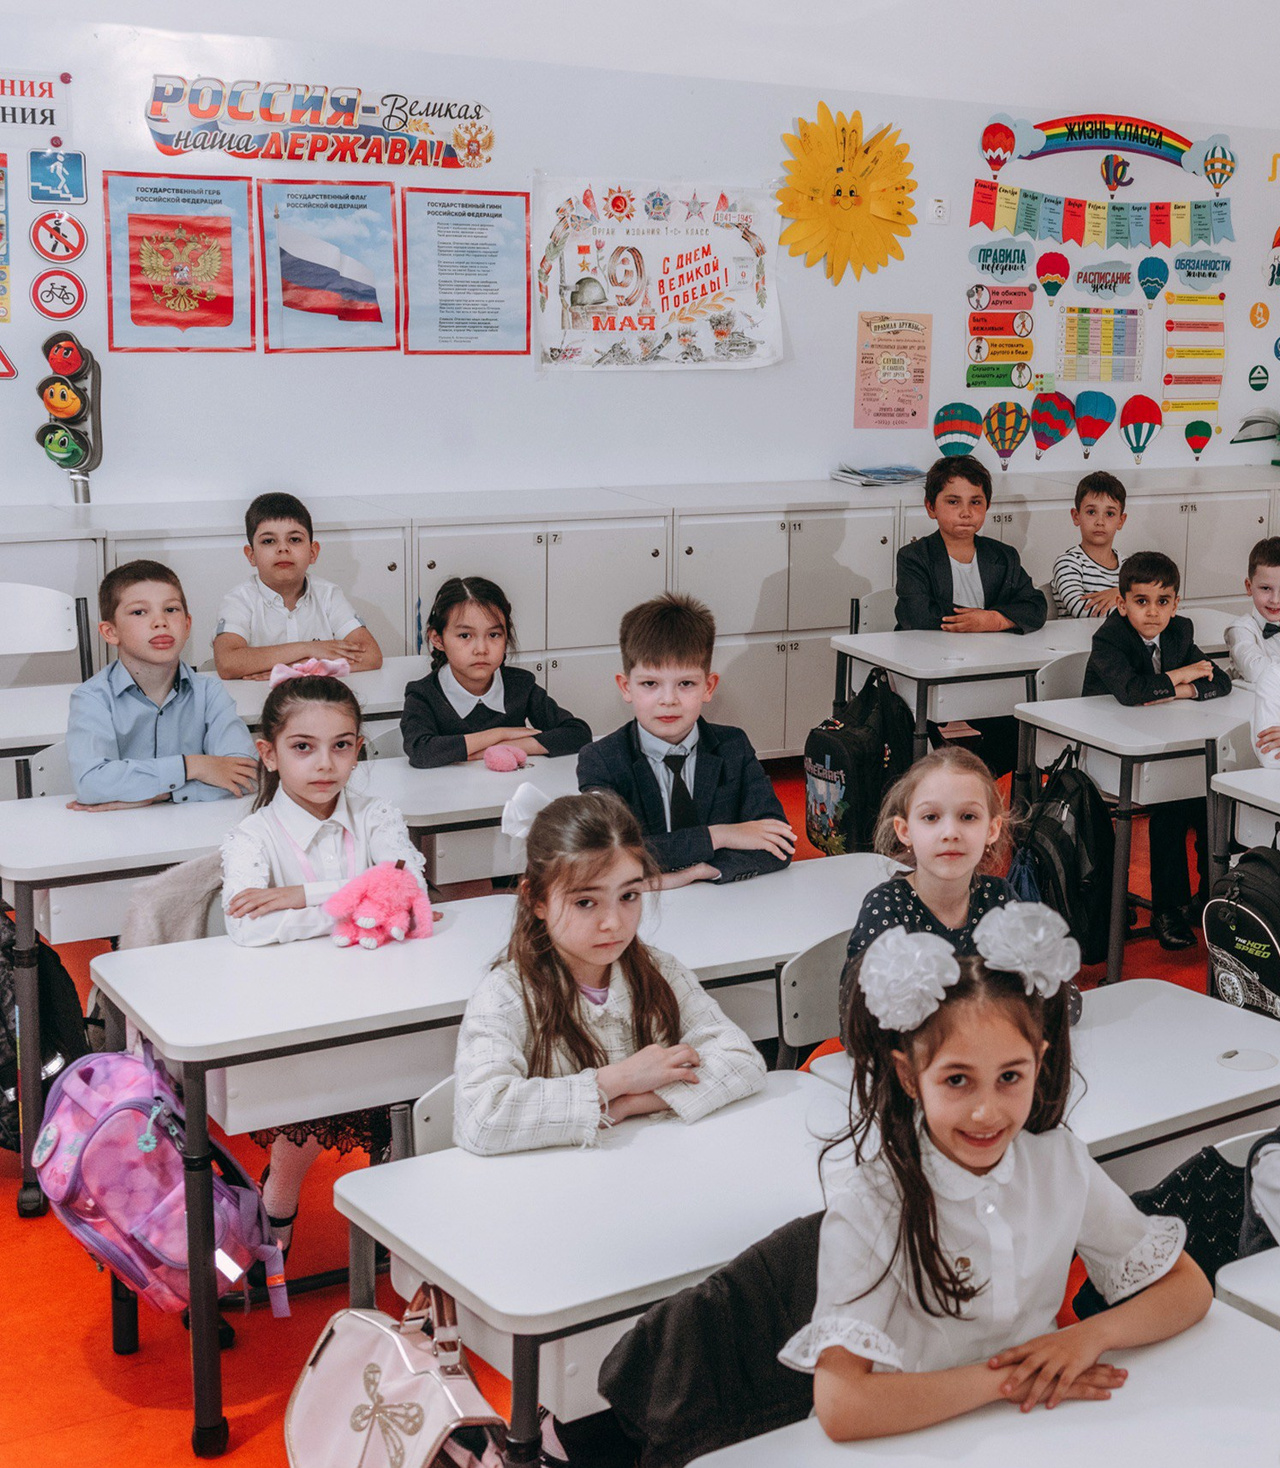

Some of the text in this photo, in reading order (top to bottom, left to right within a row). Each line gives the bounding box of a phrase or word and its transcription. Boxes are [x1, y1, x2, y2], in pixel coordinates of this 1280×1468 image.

[0, 106, 56, 125] НИЯ
[381, 93, 484, 131] Великая
[1065, 120, 1164, 149] ЖИЗНЬ КЛАССА
[173, 129, 444, 167] наша ДЕРЖАВА!
[136, 187, 203, 196] ГОСУДАРСТВЕННЫЙ
[135, 196, 222, 206] РОССИЙСКОЙ ФЕДЕРАЦИИ
[286, 193, 349, 201] ГОСУДАРСТВЕННЫЙ
[286, 202, 328, 210] РОССИЙСКОЙ
[427, 201, 485, 209] ГОСУДАРСТВЕННЫЙ
[427, 210, 466, 218] РОССИЙСКОЙ
[662, 244, 712, 275] С ДНЕМ
[978, 249, 1026, 264] ПРАВИЛА
[981, 262, 1026, 275] поведения
[1175, 259, 1231, 271] ОБЯЗАННОСТИ
[657, 256, 720, 296] ВЕЛИКОЙ
[1076, 272, 1132, 285] РАСПИСАНИЕ
[1001, 289, 1027, 297] обижать
[592, 316, 656, 331] МАЯ
[1180, 504, 1188, 512] 17
[993, 515, 1001, 523] 13
[1004, 515, 1013, 523] 15
[780, 522, 786, 531] 9
[793, 522, 801, 531] 11
[536, 535, 543, 544] 5
[552, 534, 559, 543] 7
[776, 643, 786, 652] 10
[790, 642, 799, 651] 12
[536, 663, 543, 672] 6
[551, 659, 558, 669] 8
[1235, 936, 1270, 951] THE HOT
[1234, 942, 1271, 959] SPEED
